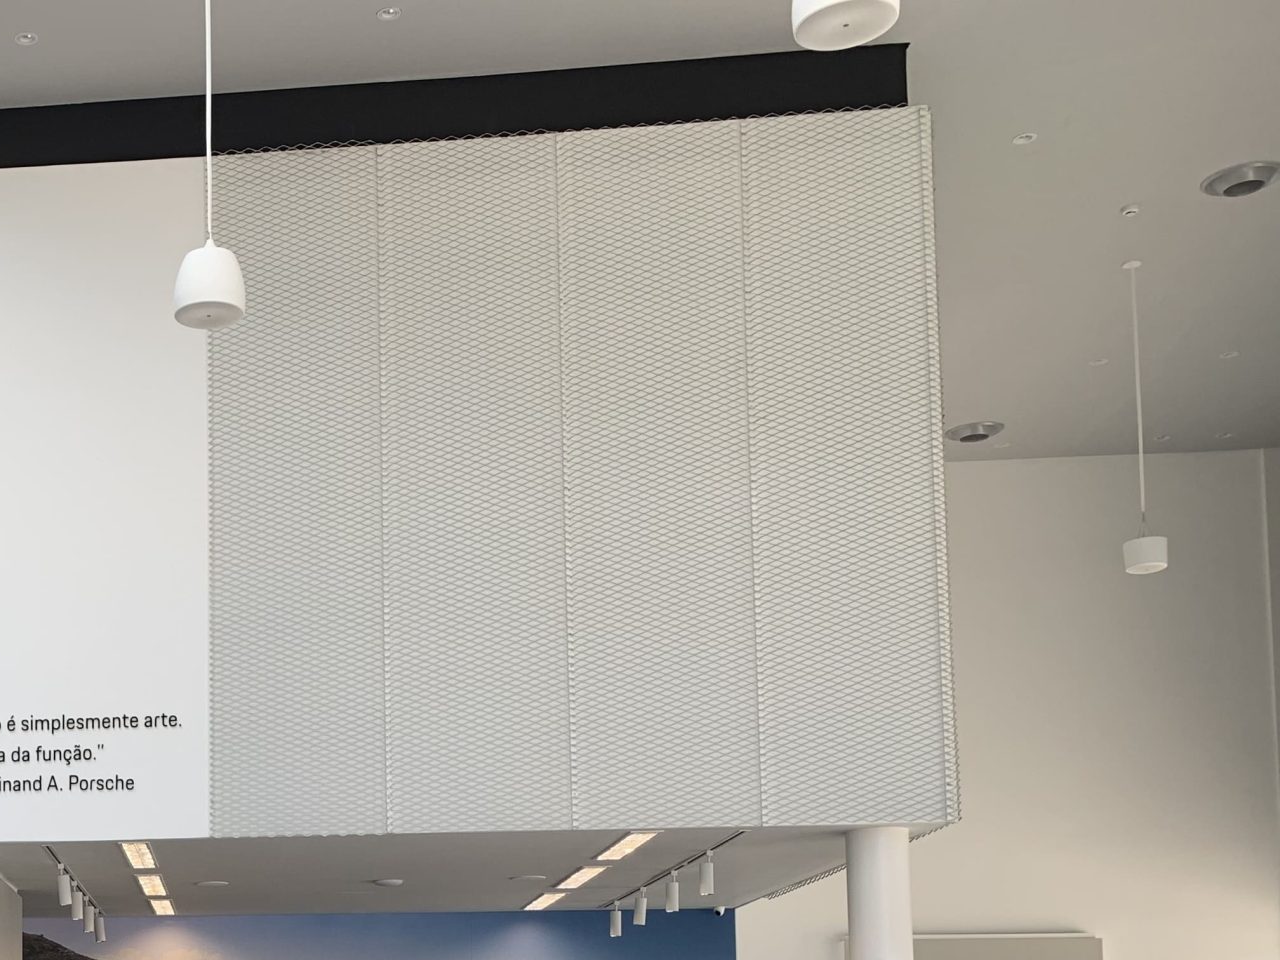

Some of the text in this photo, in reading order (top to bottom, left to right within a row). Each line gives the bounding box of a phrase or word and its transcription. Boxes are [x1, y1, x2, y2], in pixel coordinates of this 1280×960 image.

[6, 715, 16, 732] é
[20, 714, 139, 735] simplesmente
[143, 712, 182, 728] arte.
[10, 746, 31, 763] da
[46, 775, 63, 792] A.
[68, 774, 135, 791] Porsche
